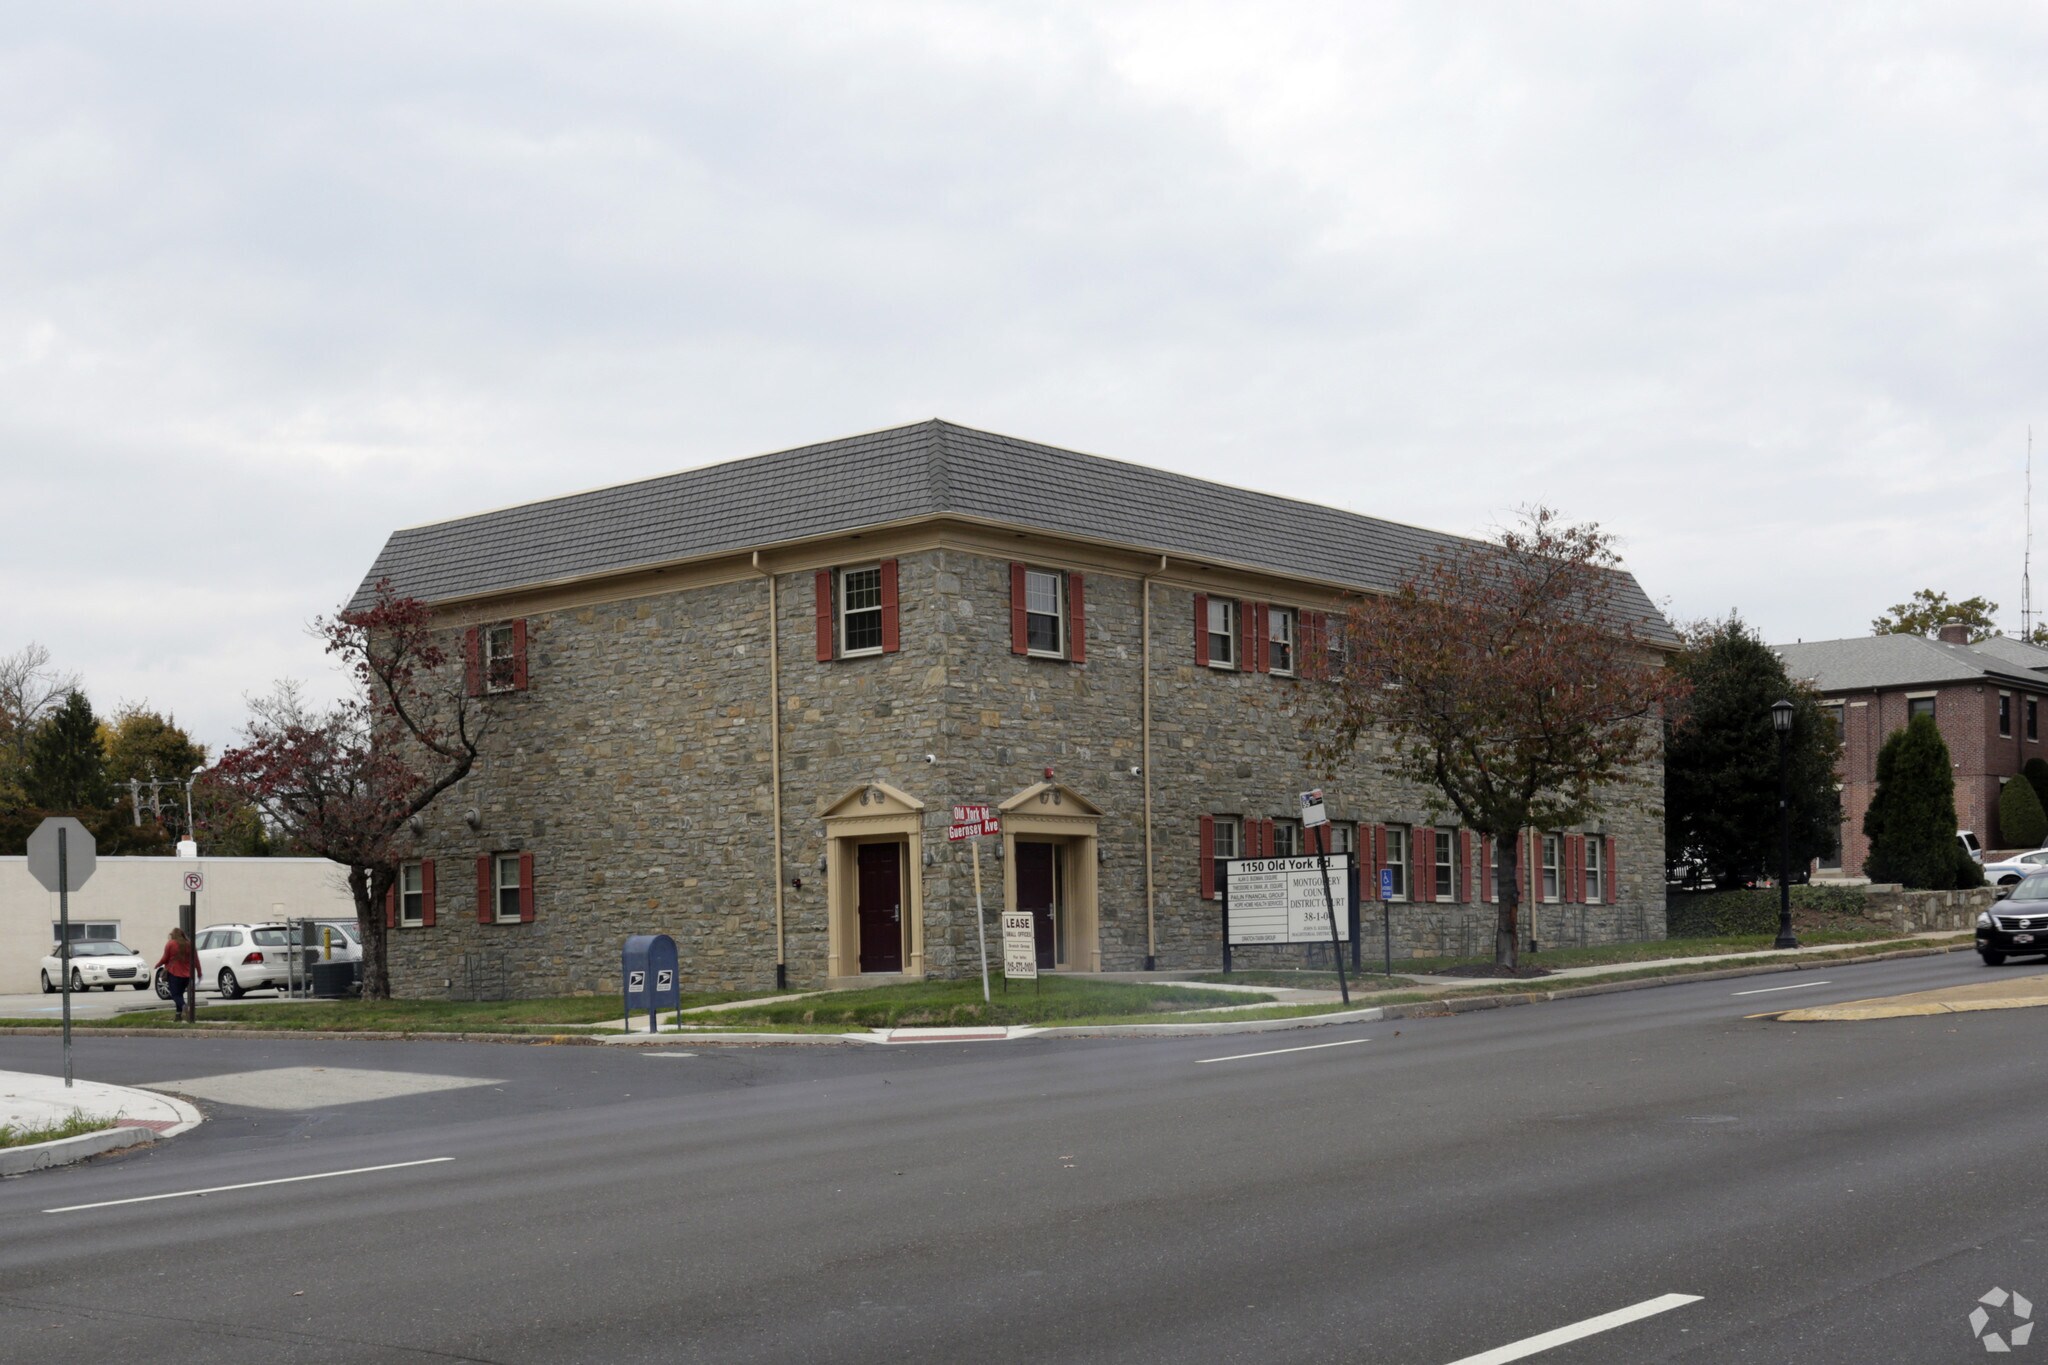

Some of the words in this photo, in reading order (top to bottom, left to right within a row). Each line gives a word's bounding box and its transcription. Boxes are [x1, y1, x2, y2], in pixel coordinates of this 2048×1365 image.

[954, 806, 965, 820] Old
[965, 806, 980, 820] York
[981, 807, 990, 820] Rd
[949, 823, 982, 839] Guernsey
[984, 820, 998, 832] Ave
[1241, 861, 1264, 872] 1150
[1267, 860, 1286, 871] Old
[1288, 858, 1313, 870] York
[1292, 876, 1341, 887] MONTGOERY
[1303, 887, 1328, 898] COUN
[1290, 899, 1320, 909] DISTRICT
[1321, 897, 1345, 907] CURT
[1303, 911, 1330, 922] 38-1-0
[1006, 918, 1030, 928] LEASE
